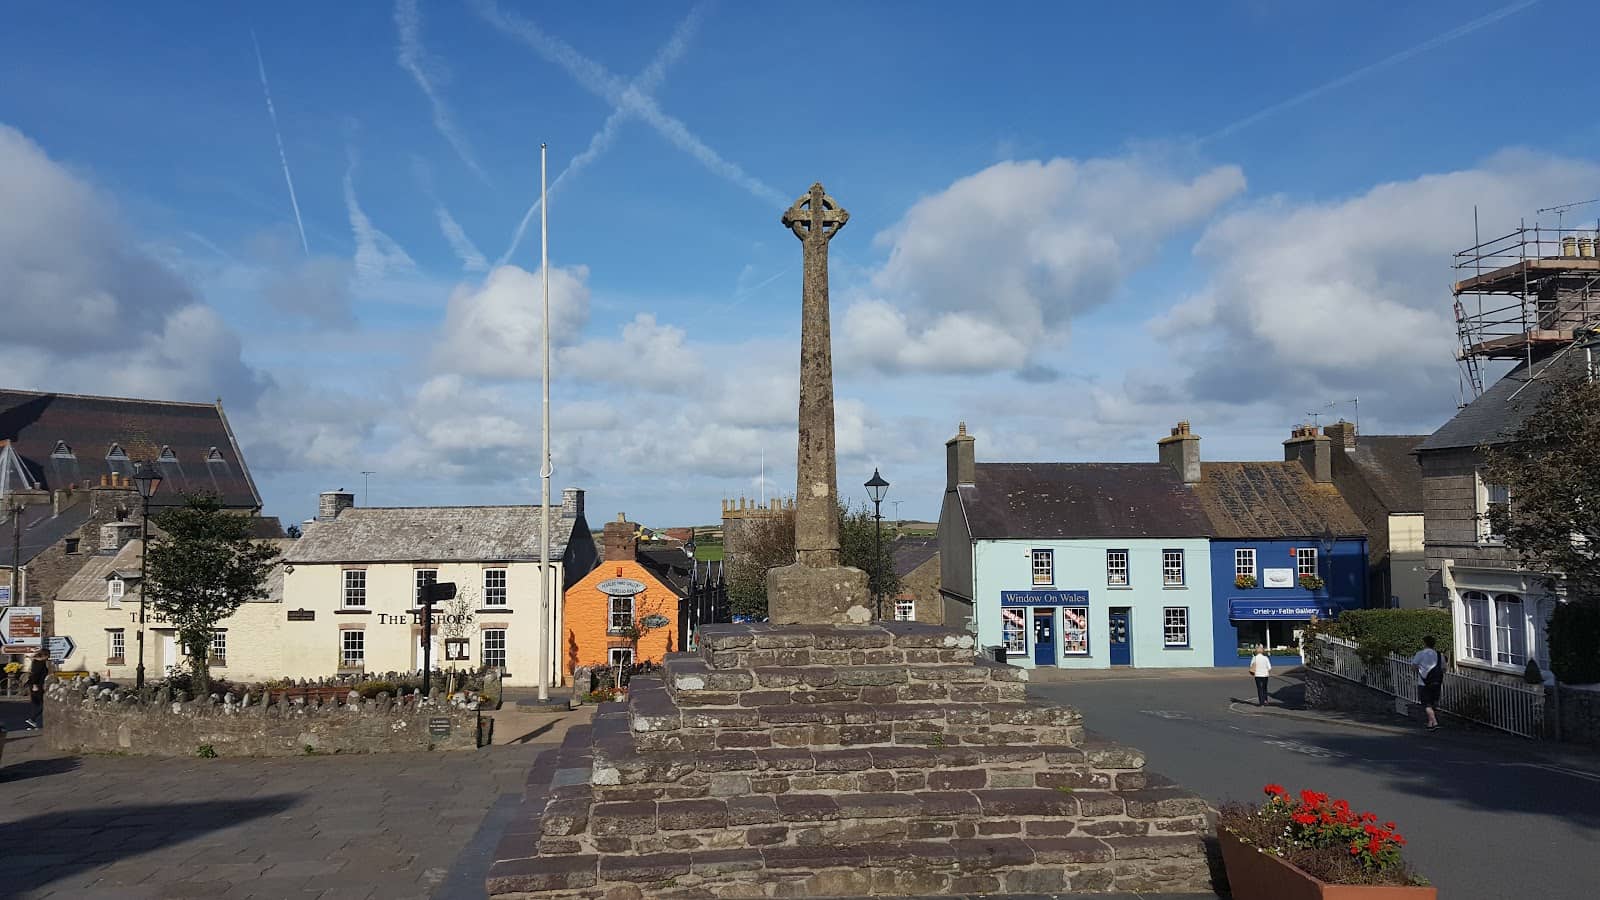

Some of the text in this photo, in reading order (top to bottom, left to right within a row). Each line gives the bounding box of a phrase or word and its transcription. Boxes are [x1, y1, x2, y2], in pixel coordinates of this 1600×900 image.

[1006, 593, 1086, 603] Window On Wales
[1295, 607, 1320, 615] Gallery
[129, 612, 151, 623] TE
[377, 613, 473, 625] THE BSHOPS
